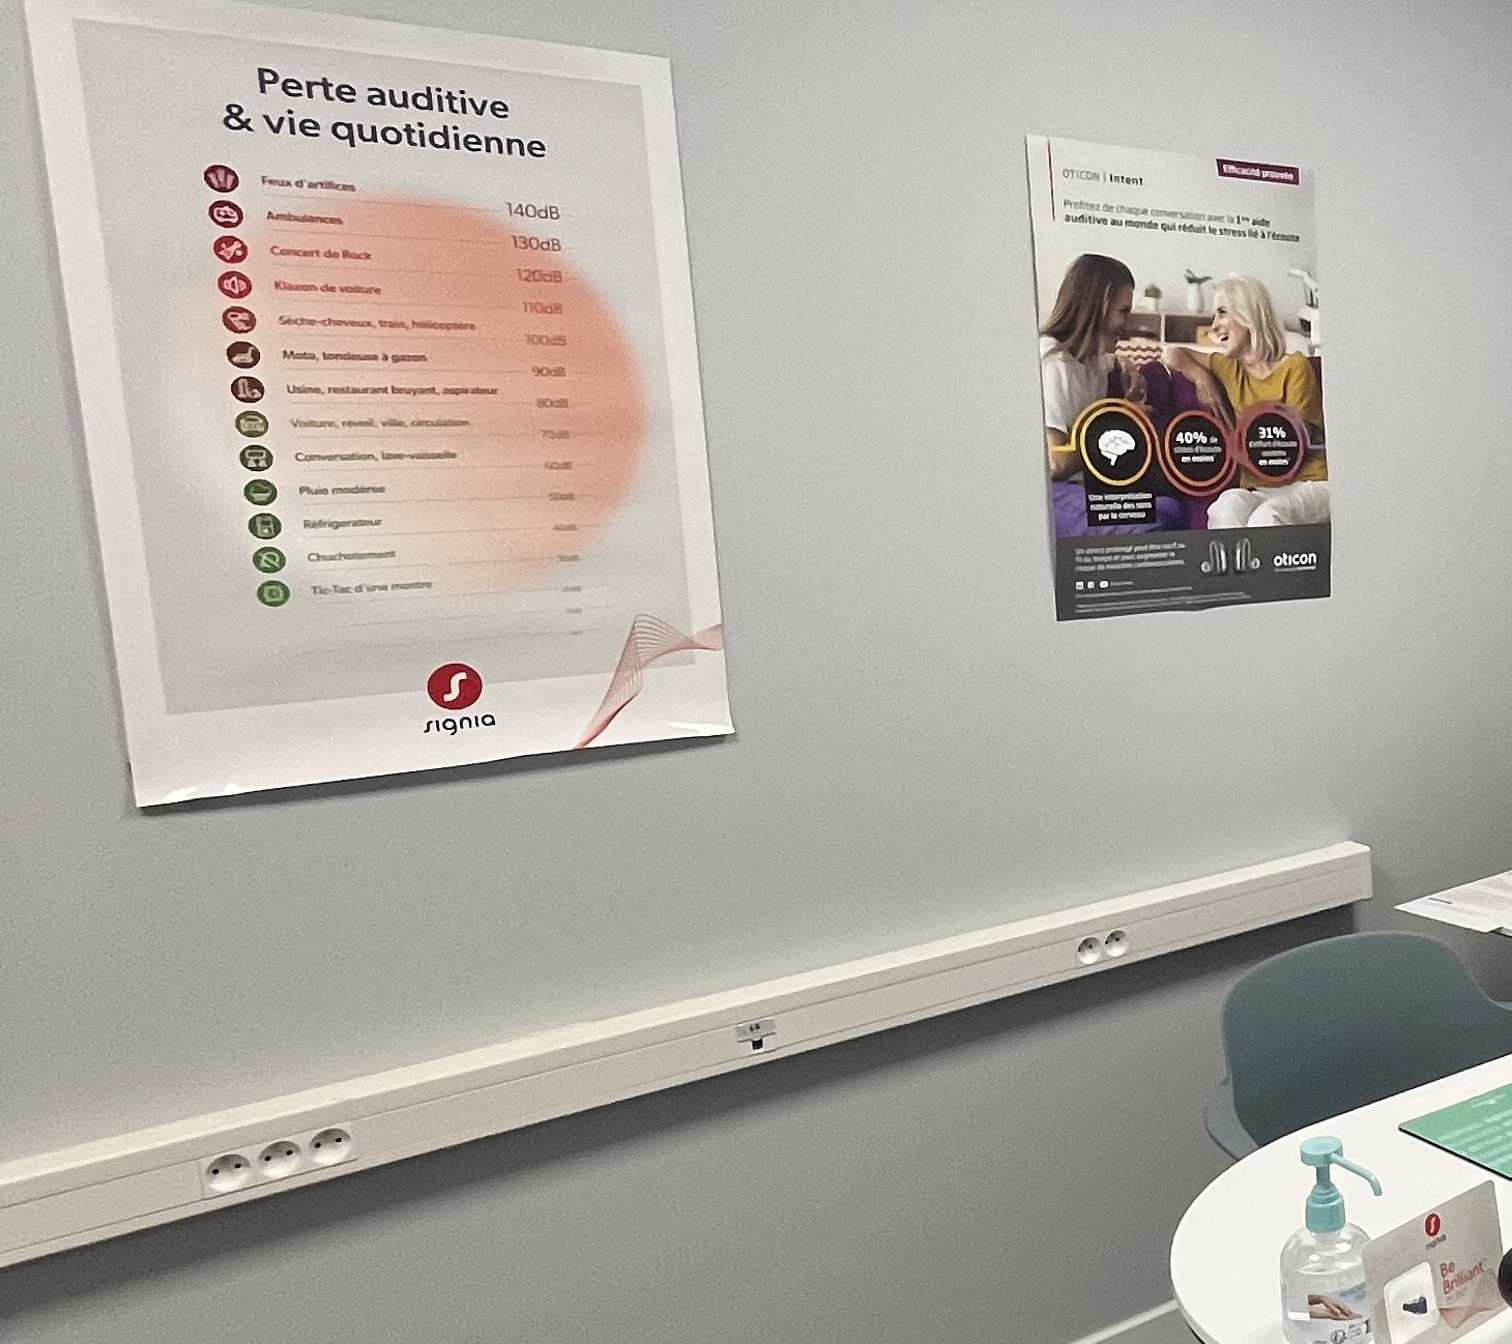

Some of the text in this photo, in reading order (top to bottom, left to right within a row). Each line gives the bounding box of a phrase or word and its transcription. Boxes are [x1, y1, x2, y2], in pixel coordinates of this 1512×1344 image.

[258, 67, 510, 119] Perte auditive
[223, 104, 547, 158] & vie quotidienne
[261, 175, 291, 188] Feux
[1062, 168, 1144, 186] OTICON Intent
[506, 202, 560, 220] 140dB
[1102, 203, 1114, 213] de
[1116, 204, 1149, 216] chaque
[266, 210, 343, 225] Ambulances
[1064, 213, 1108, 226] auditive
[1110, 218, 1123, 227] au
[1125, 219, 1159, 230] monde
[1160, 221, 1176, 232] qui
[1208, 225, 1218, 235] le
[1218, 227, 1247, 238] stress
[512, 235, 562, 252] 130dB
[270, 245, 372, 261] Concert de Rock
[516, 268, 563, 283] 120dB
[274, 280, 381, 295] Klaxon de voiture
[522, 301, 563, 315] 110dB
[282, 350, 319, 361] Moto,
[322, 350, 379, 362] tondeuse
[391, 353, 428, 363] gazon
[531, 366, 566, 377] 90dB
[287, 384, 498, 397] Usine, restaurant bruyant, aspirateur
[290, 418, 339, 429] Voiture,
[410, 418, 470, 428] circulation
[1175, 431, 1208, 444] 40%
[1258, 426, 1287, 439] 31%
[295, 452, 378, 462] Conversation,
[1273, 552, 1317, 567] oticon
[391, 581, 433, 591] montre
[423, 714, 496, 736] signia
[1440, 1261, 1455, 1278] Be
